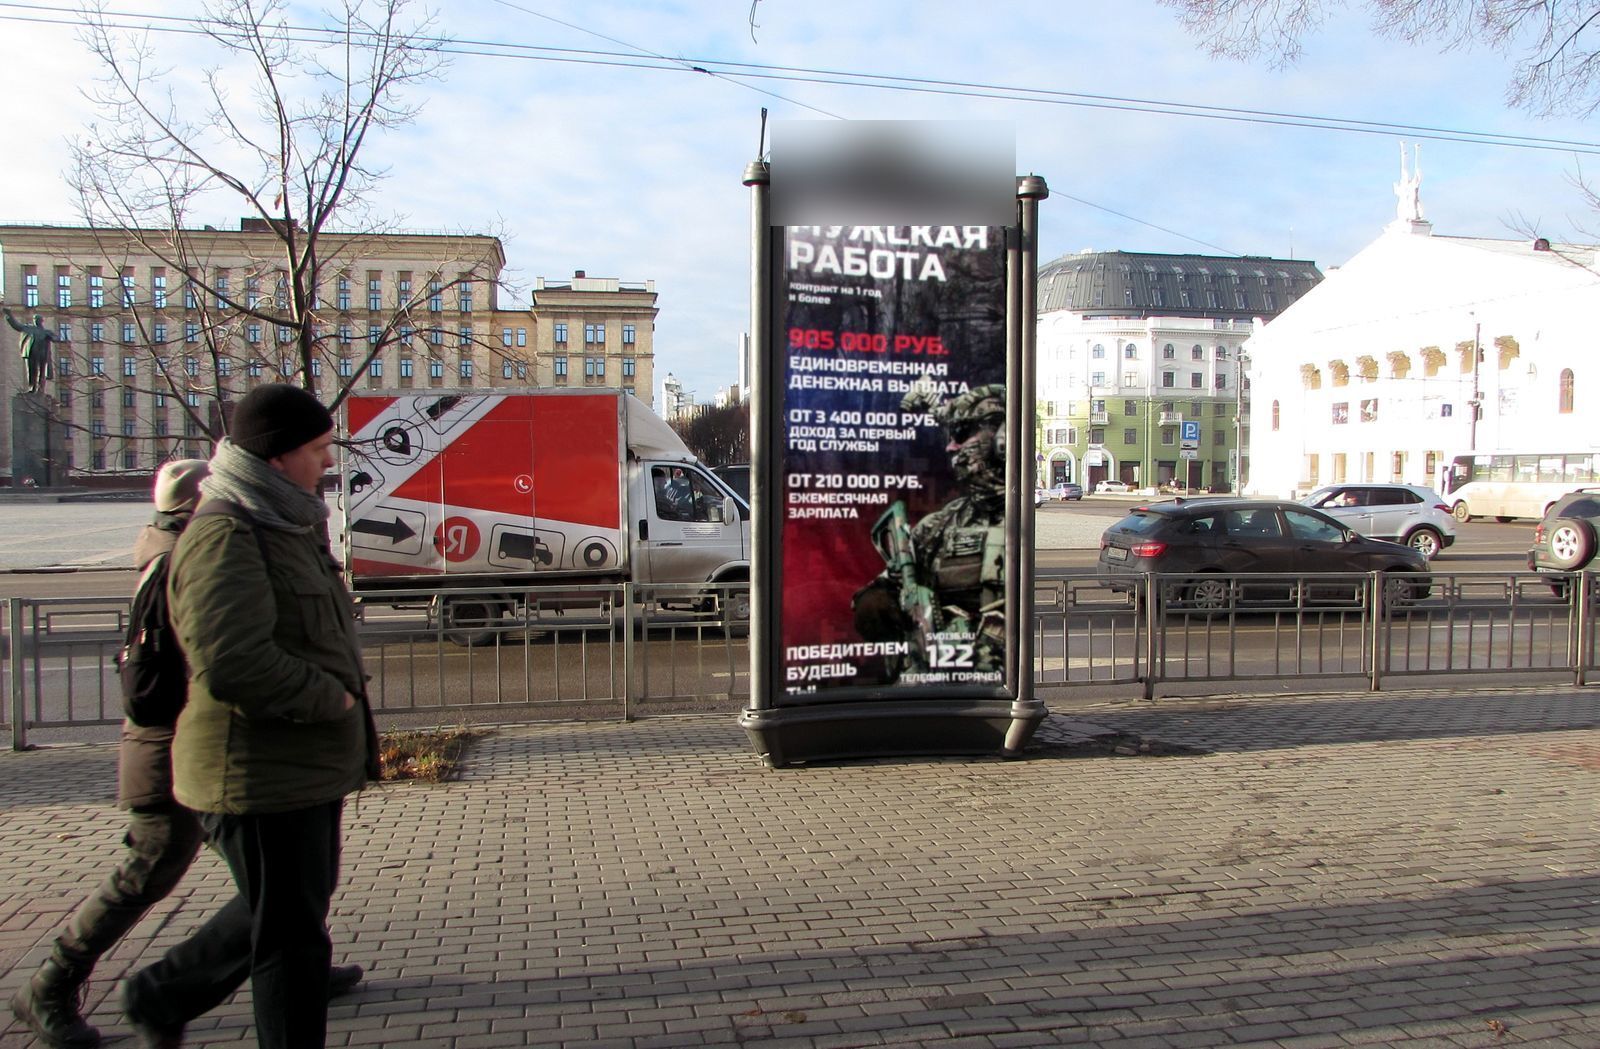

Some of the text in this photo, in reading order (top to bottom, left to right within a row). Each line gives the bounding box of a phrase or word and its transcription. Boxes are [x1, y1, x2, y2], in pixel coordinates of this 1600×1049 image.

[790, 240, 947, 282] РАБОТА
[789, 282, 883, 298] контракт на 1 год
[798, 293, 832, 304] более
[789, 328, 950, 355] 905 000 РУБ.
[789, 356, 948, 376] ЕДИНОВРЕМЕННАЯ
[789, 375, 970, 394] ДЕНЕЖНАЯ ВЫПЛАТА
[789, 409, 940, 427] ОТ 3 400 000 РУБ.
[789, 426, 916, 441] ДОХОД ЗА ПЕРВЫЙ
[1185, 423, 1197, 438] P
[789, 439, 879, 452] ГОД СЛУЖБЫ
[788, 473, 923, 489] ОТ 210 000 РУБ.
[788, 492, 888, 505] ЕЖЕМЕСЯЧНАЯ
[788, 507, 859, 519] ЗАРПЛАТА
[445, 525, 469, 554] Я
[786, 641, 909, 661] ПОБЕДИТЕЛЕМ
[925, 643, 974, 667] 122
[786, 662, 858, 681] БУДЕШЬ
[900, 670, 1002, 683] ТЕЛЕФОН ГОРЯЧЕЙ
